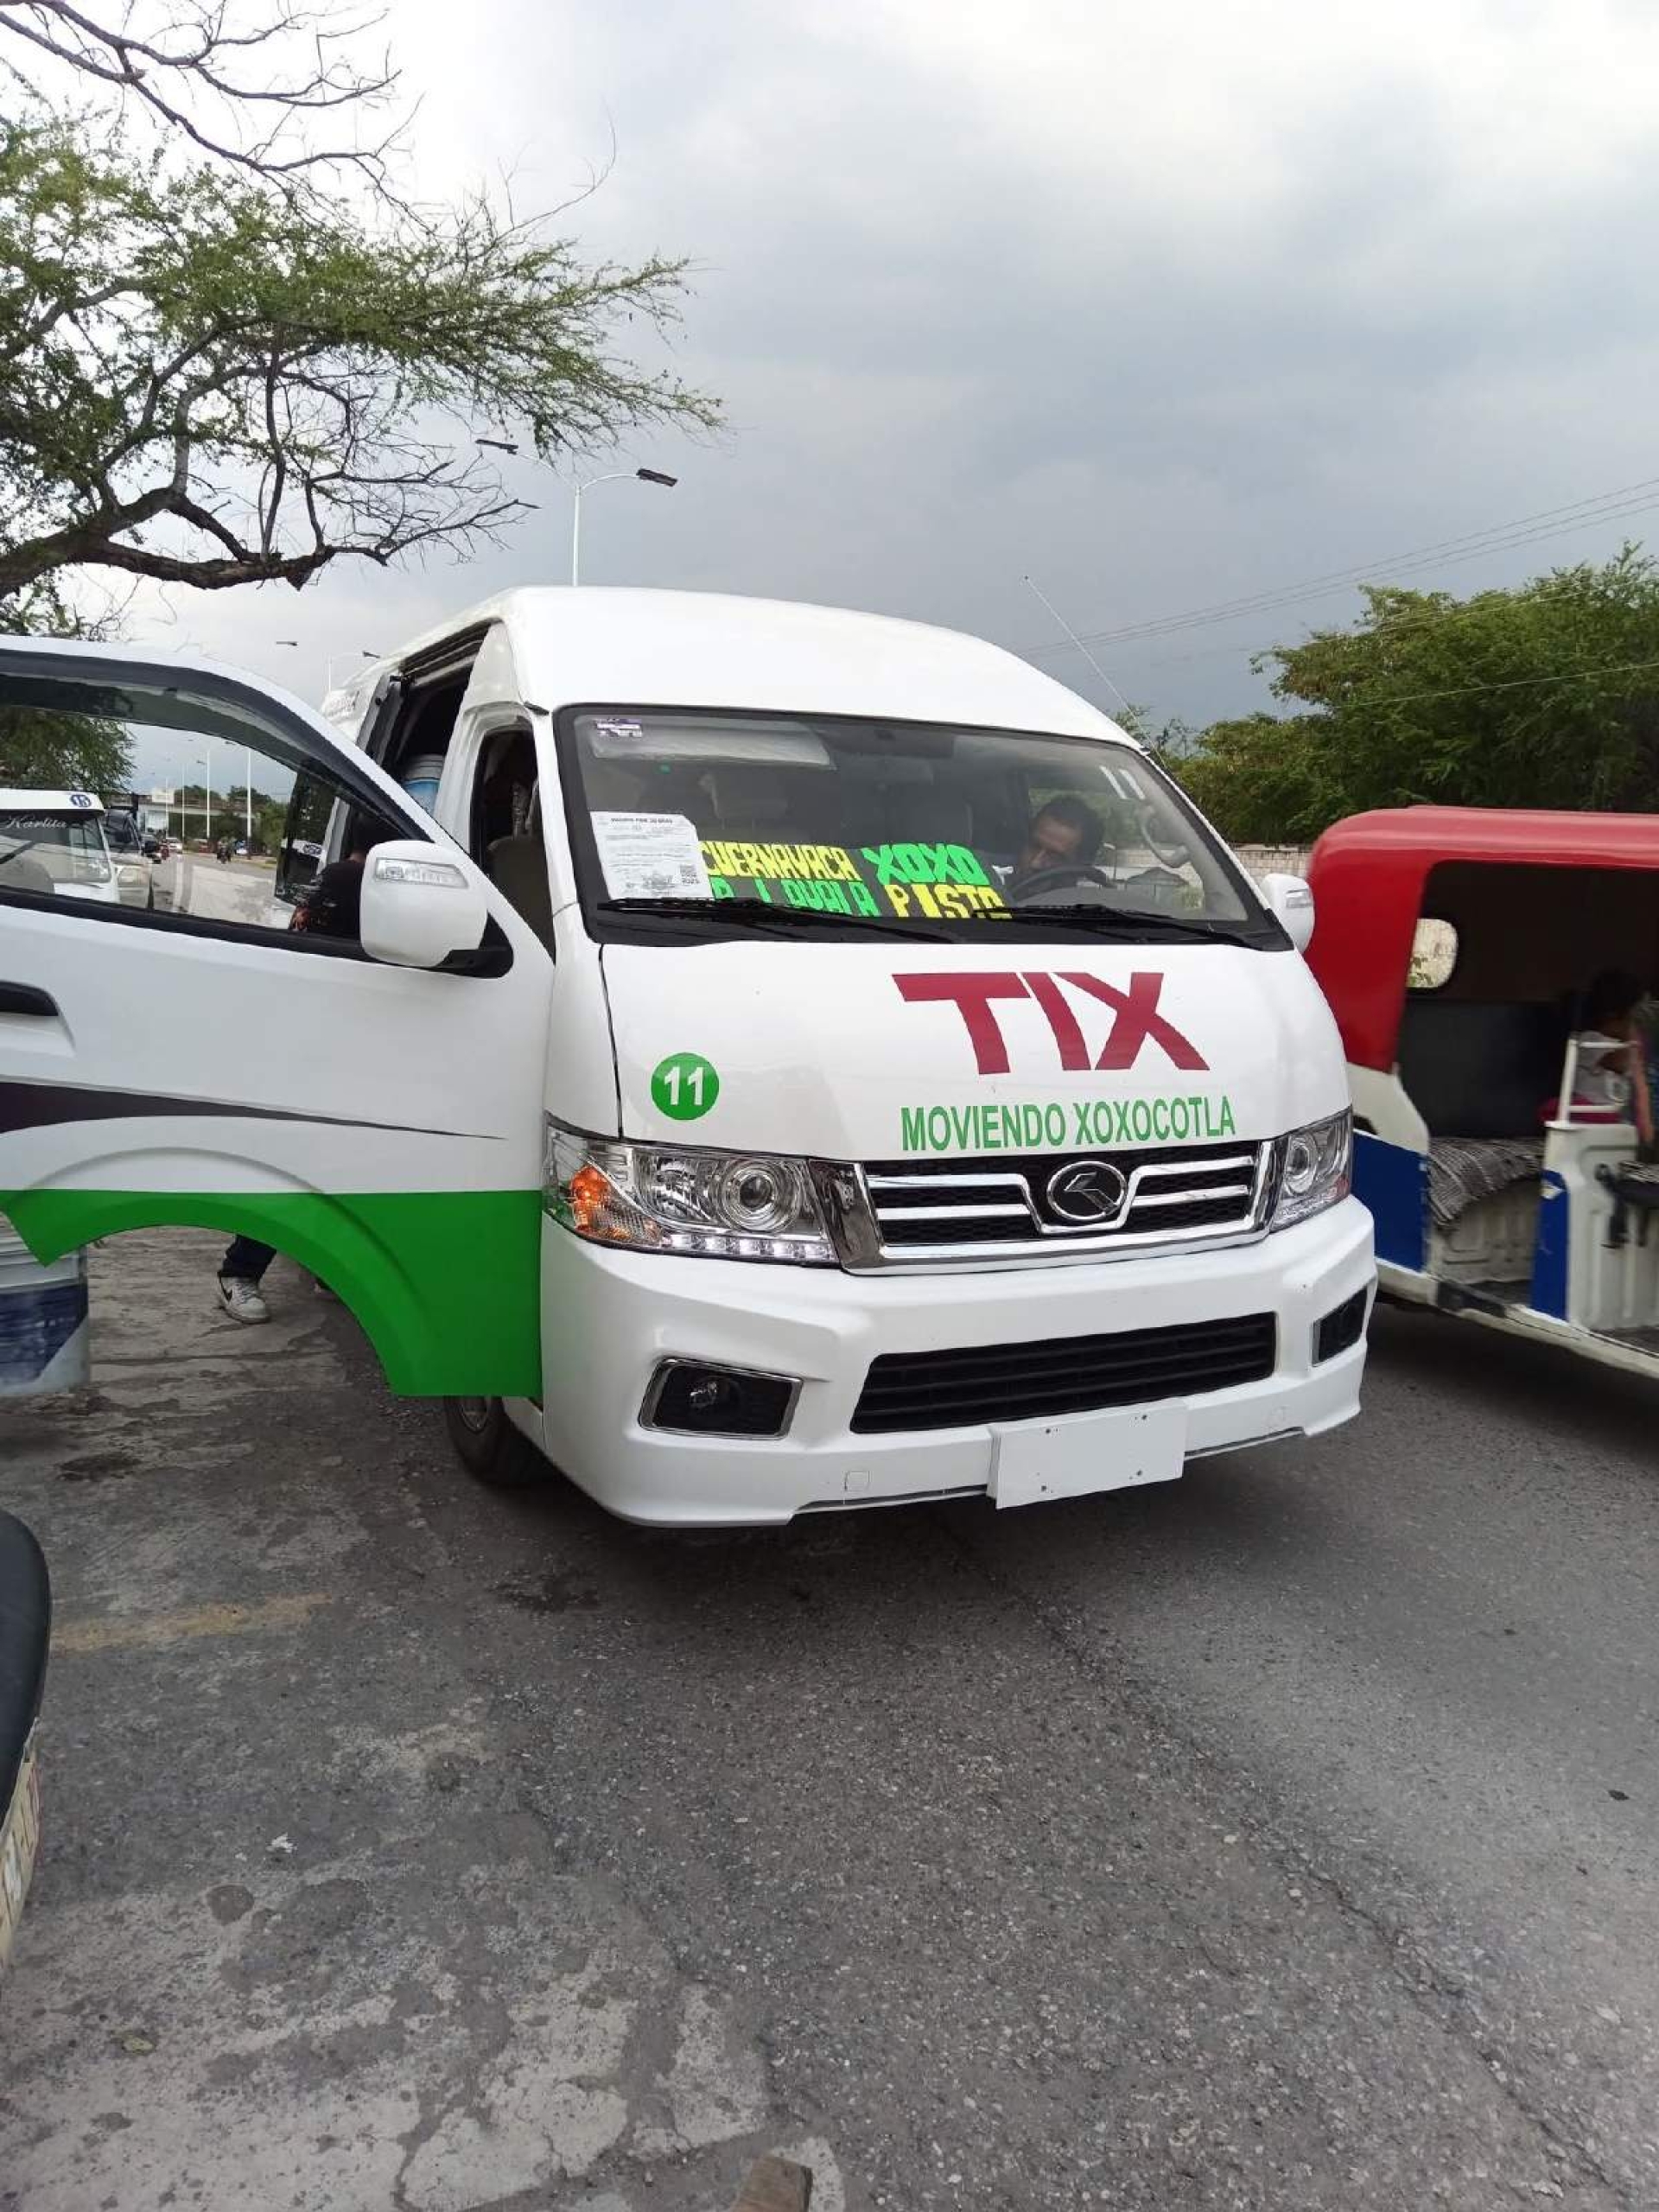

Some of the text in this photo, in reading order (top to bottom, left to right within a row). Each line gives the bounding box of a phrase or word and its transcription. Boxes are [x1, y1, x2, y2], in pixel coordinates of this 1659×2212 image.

[699, 841, 862, 880] CUERNAVACA
[861, 842, 990, 885] XOXO
[892, 972, 1210, 1075] TIX
[664, 1066, 703, 1105] 11
[901, 1096, 1236, 1151] MOVIENDO XOXOCOTLA
